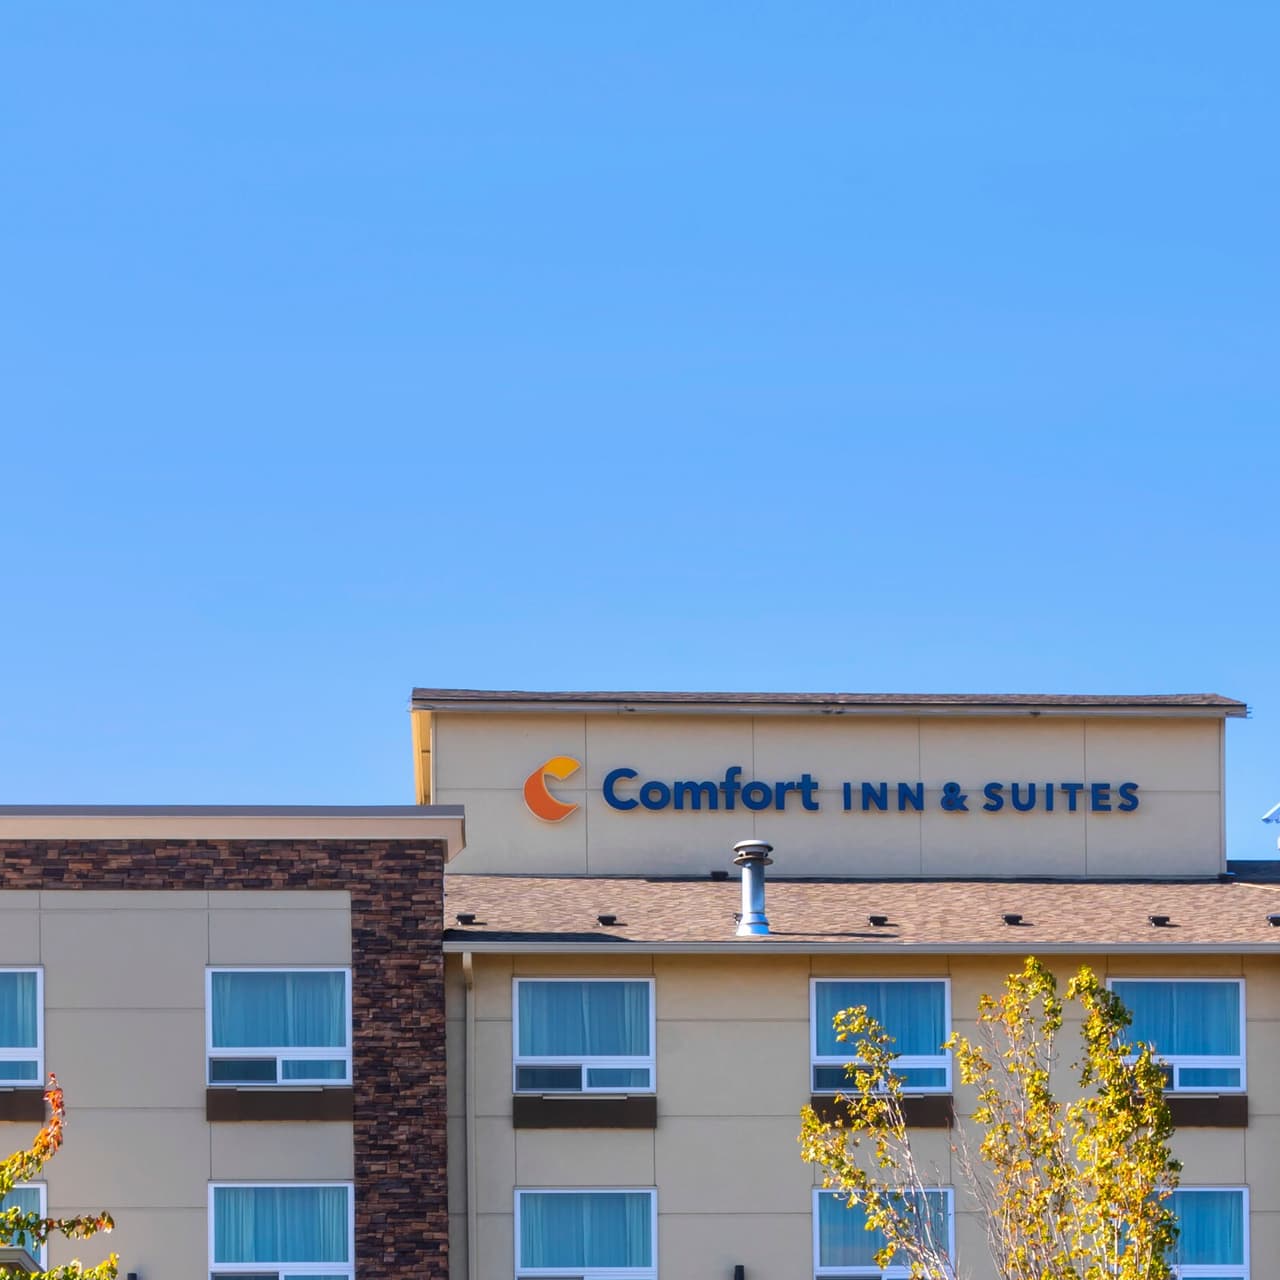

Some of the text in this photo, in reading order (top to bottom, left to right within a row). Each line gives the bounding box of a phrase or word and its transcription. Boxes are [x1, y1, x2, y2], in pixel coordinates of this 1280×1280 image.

[603, 766, 1139, 812] Comfort INN & SUITES
